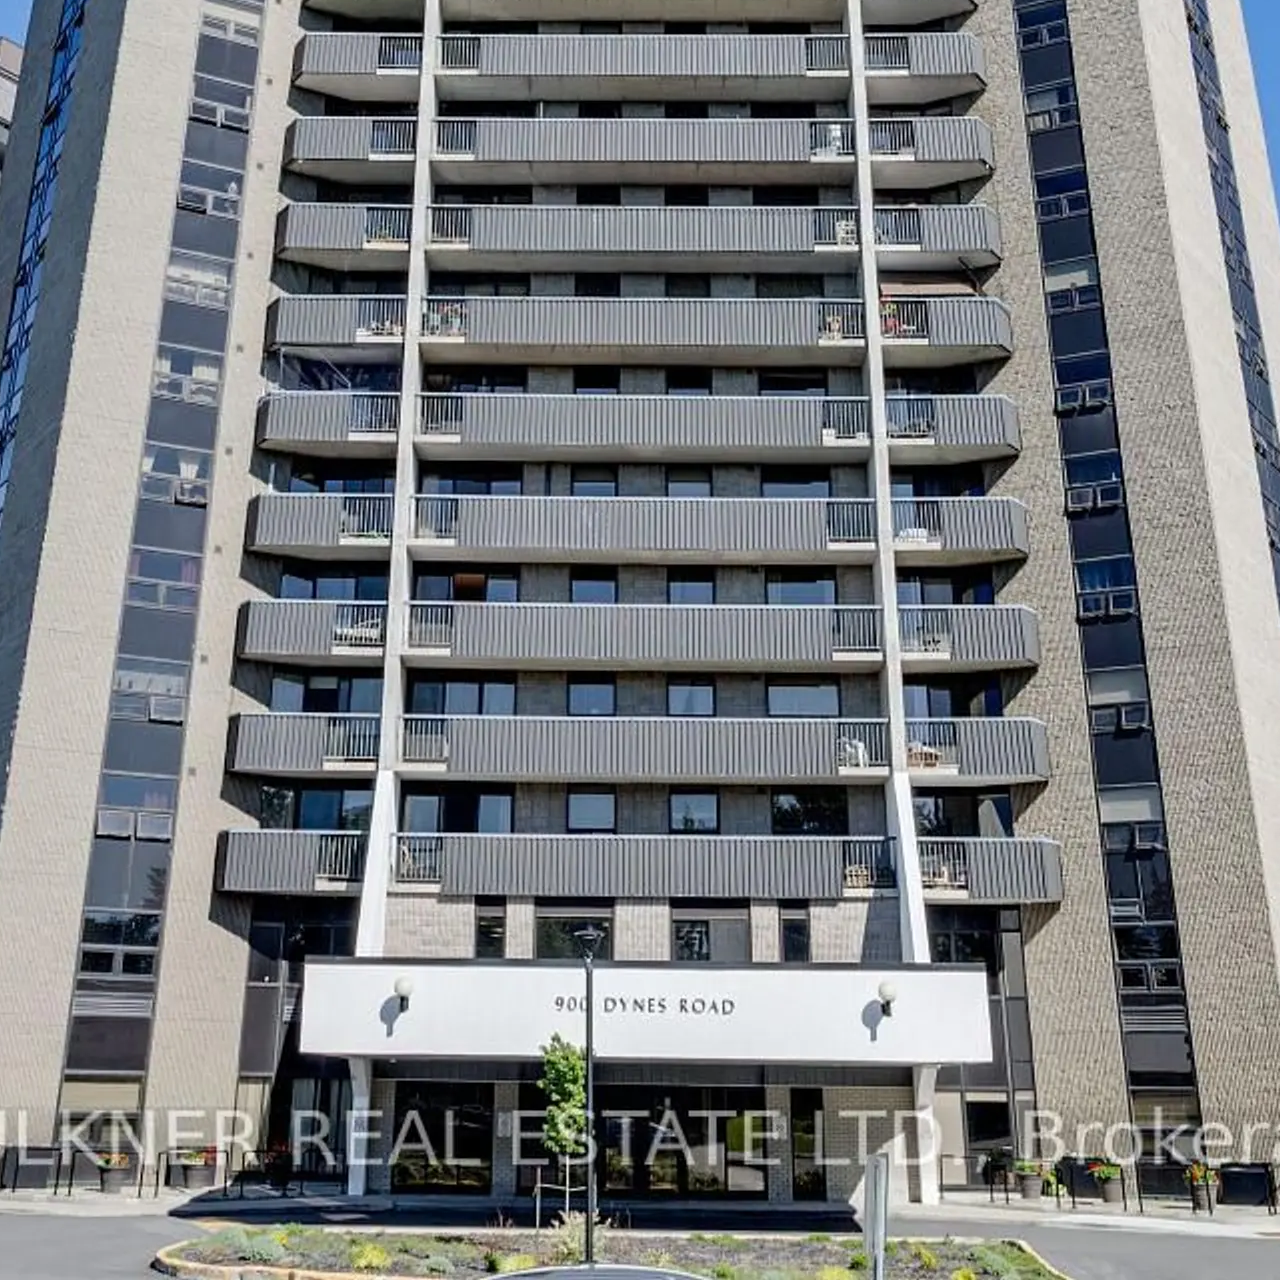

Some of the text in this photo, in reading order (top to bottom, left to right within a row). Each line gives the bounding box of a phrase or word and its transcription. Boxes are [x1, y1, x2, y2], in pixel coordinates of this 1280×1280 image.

[554, 995, 736, 1016] 900 DYNES ROAD
